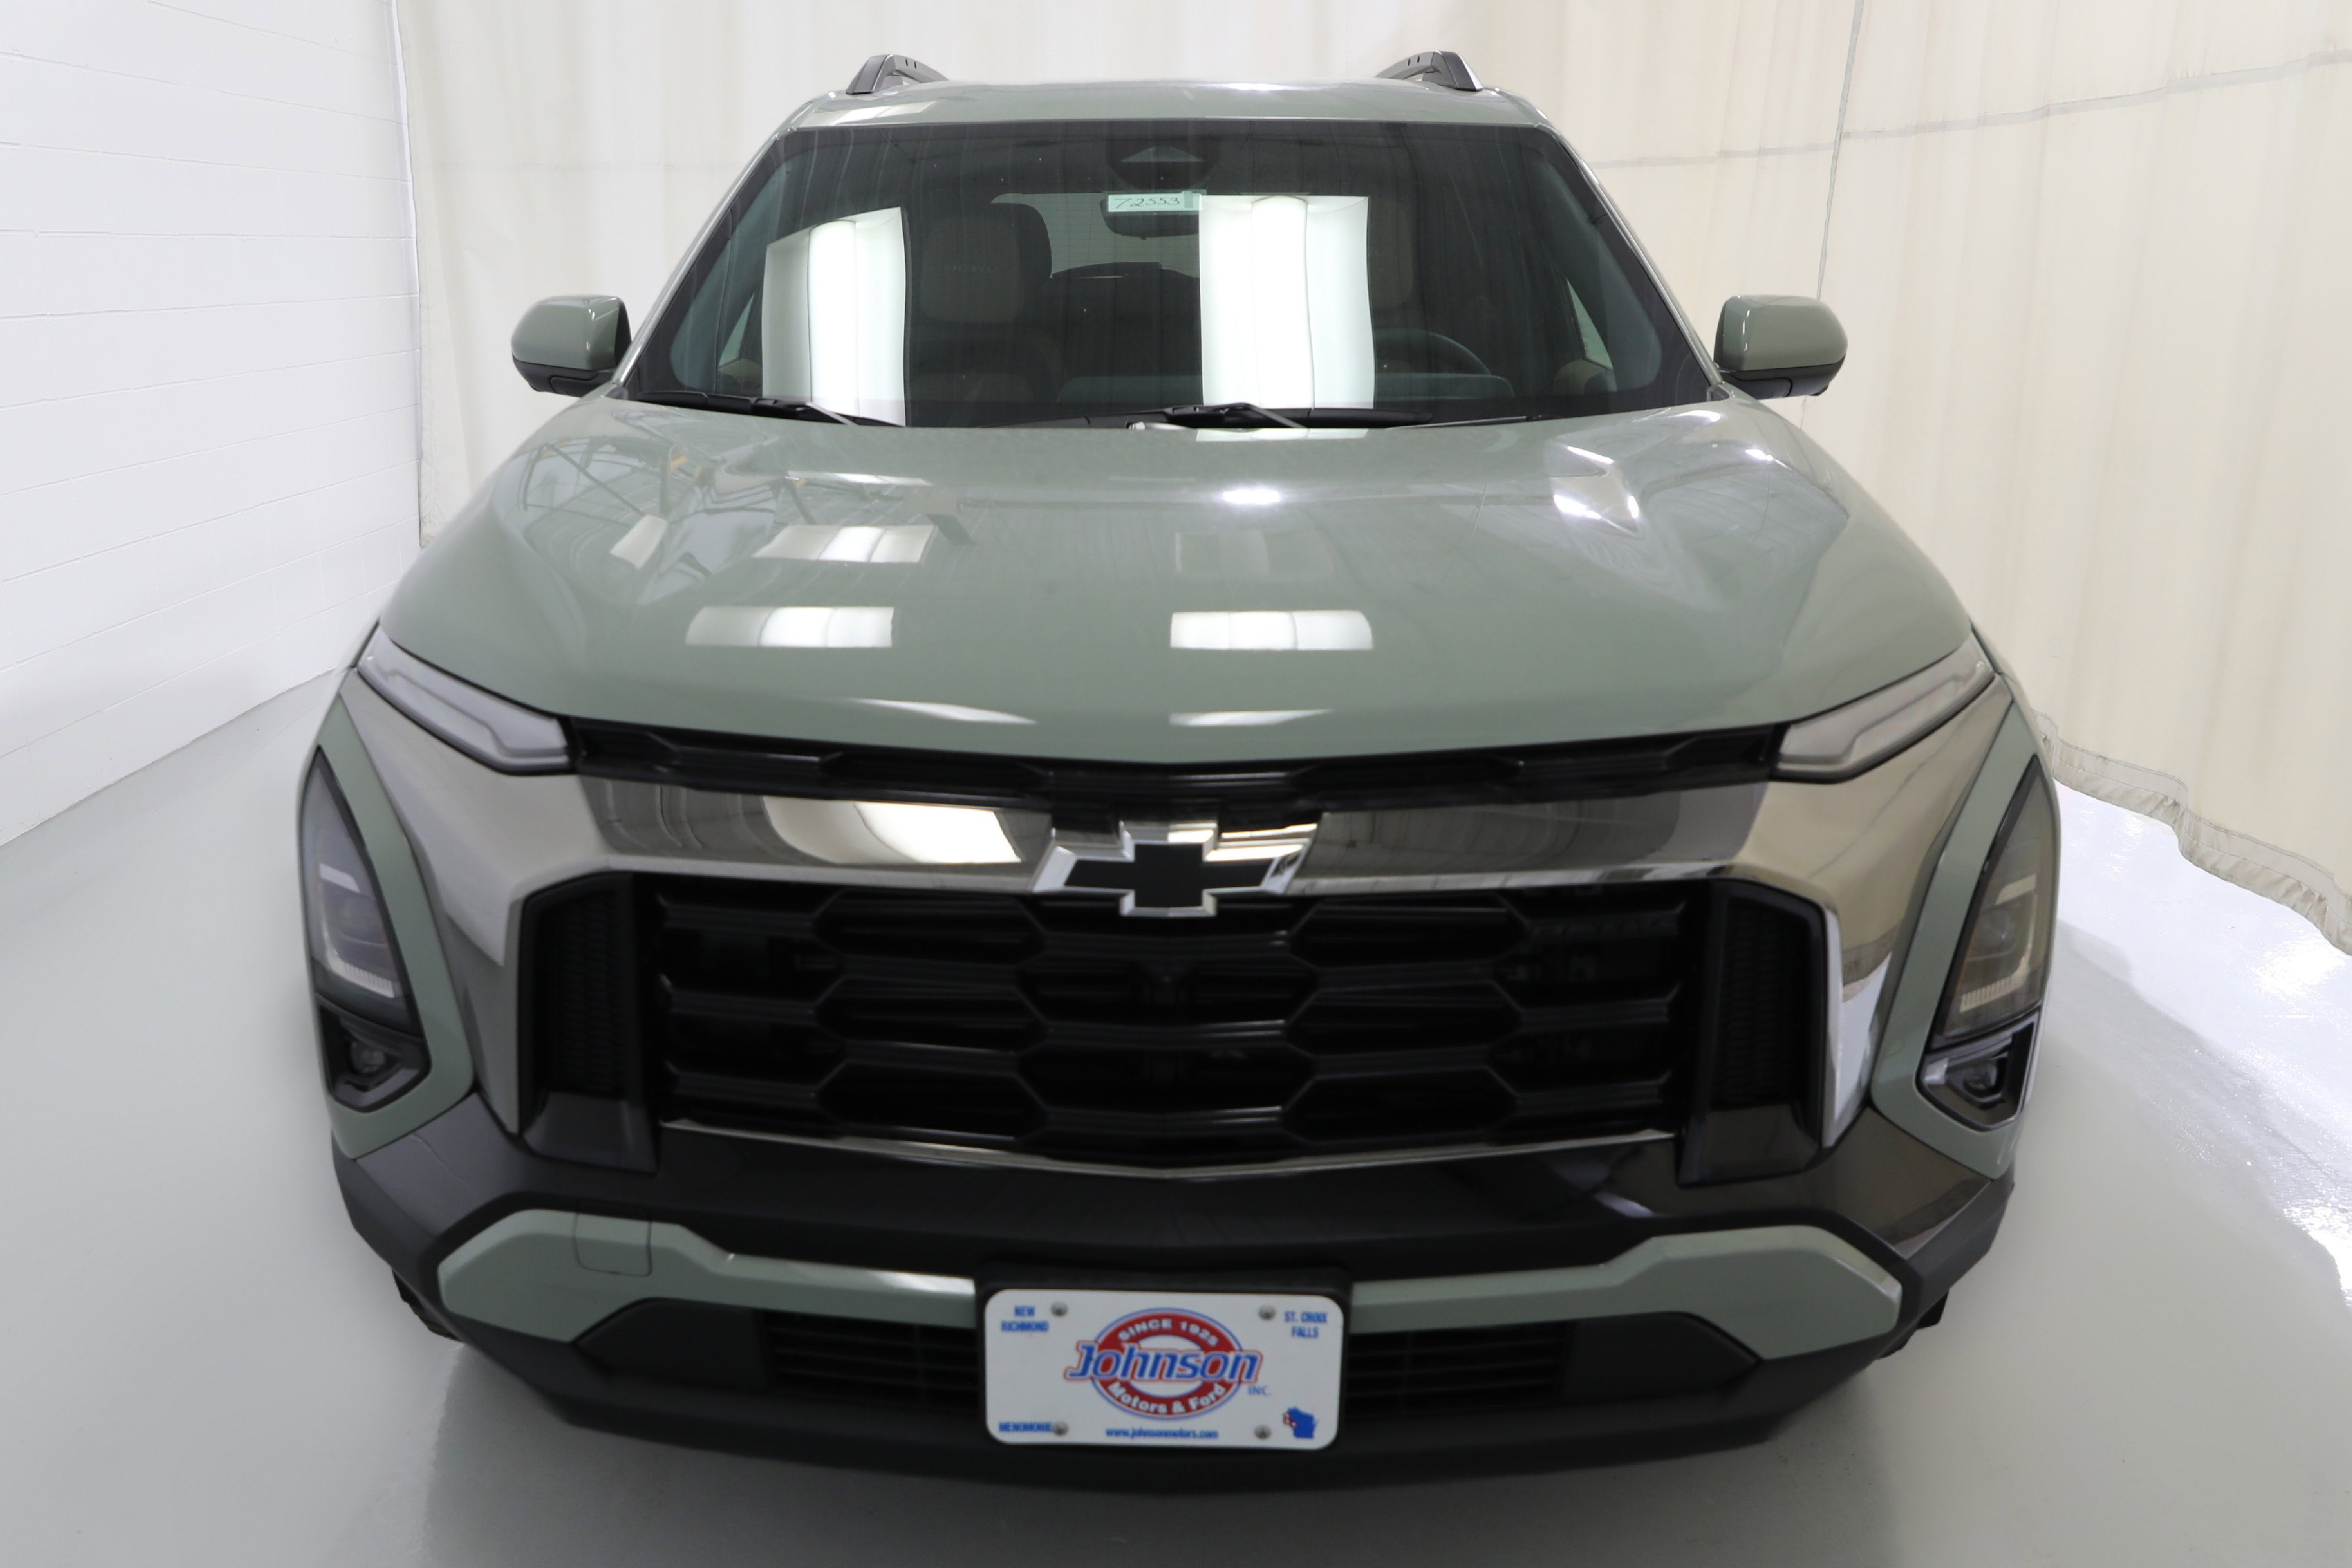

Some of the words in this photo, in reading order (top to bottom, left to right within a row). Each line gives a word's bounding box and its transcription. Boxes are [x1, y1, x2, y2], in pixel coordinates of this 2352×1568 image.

[1015, 1306, 1035, 1316] NEW
[1118, 1318, 1173, 1342] SINCE
[1291, 1326, 1319, 1338] FALLS
[1064, 1340, 1263, 1383] Johnson
[1108, 1382, 1168, 1414] Motors
[1172, 1400, 1185, 1414] &
[1188, 1383, 1226, 1410] Ford
